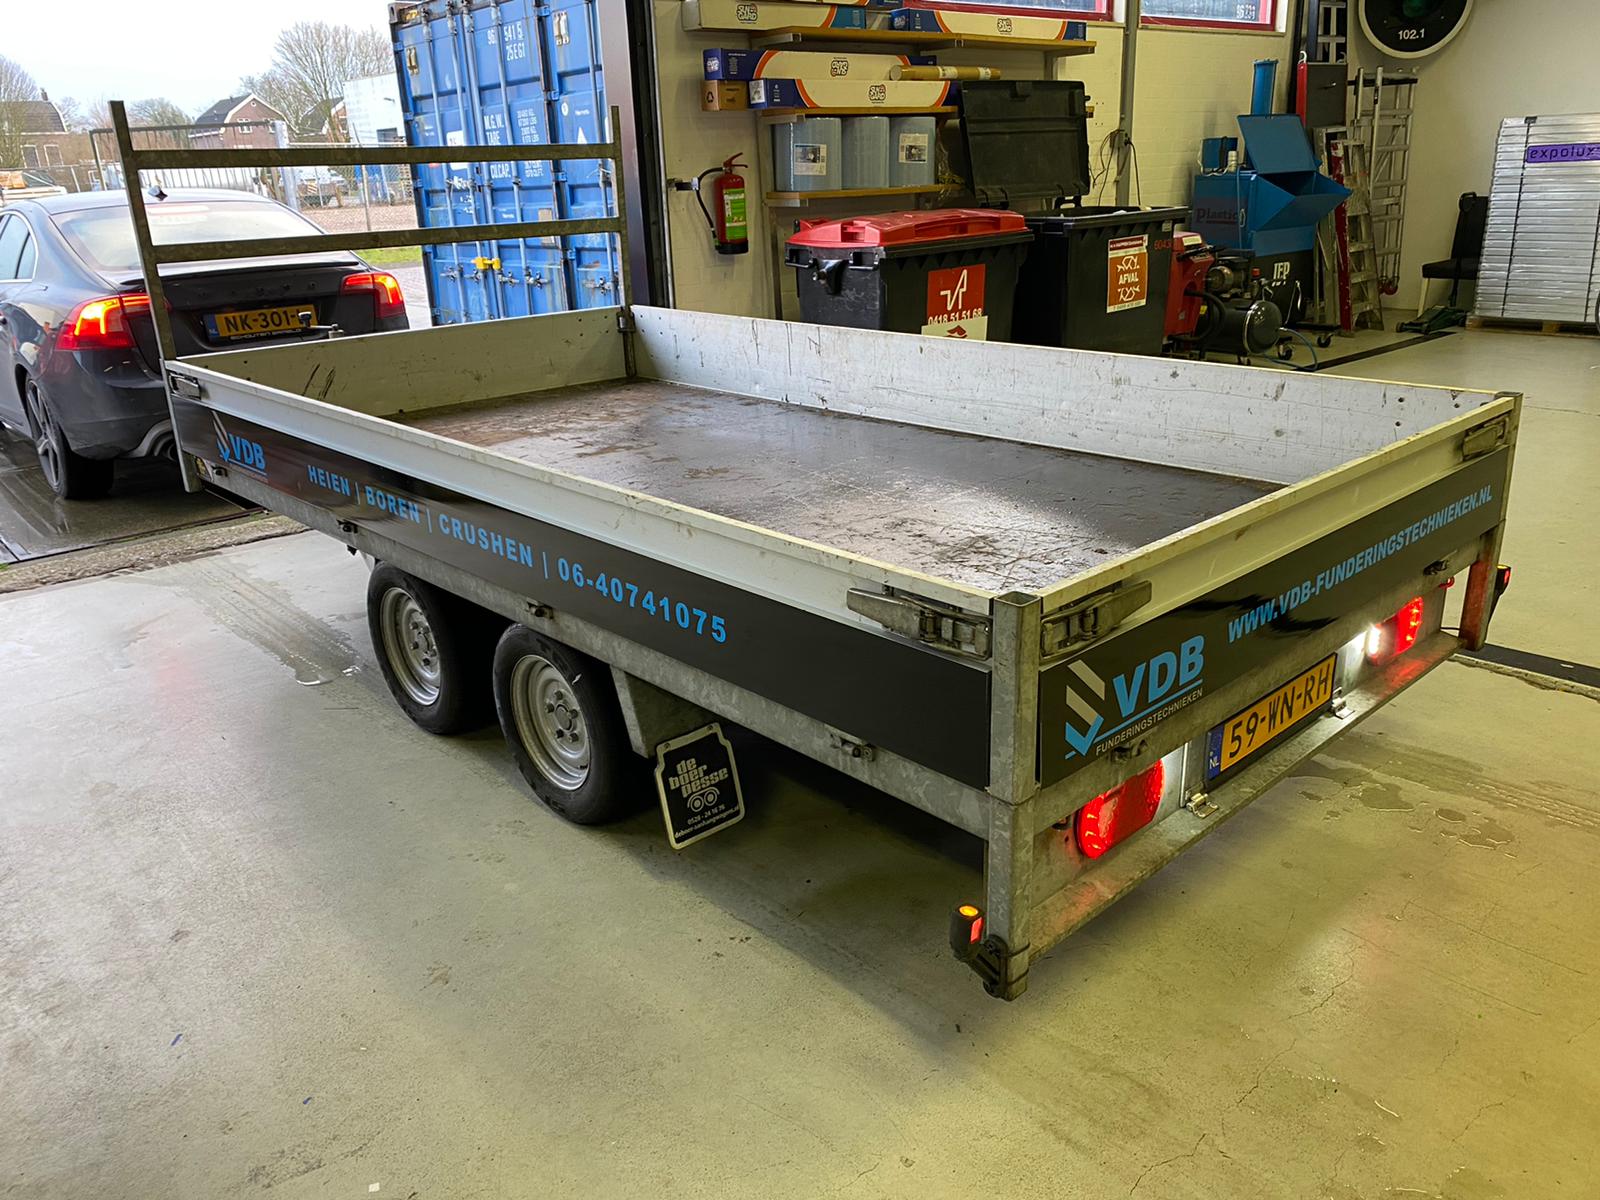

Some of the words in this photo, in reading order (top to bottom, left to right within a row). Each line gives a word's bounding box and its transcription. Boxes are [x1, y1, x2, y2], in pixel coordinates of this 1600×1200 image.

[1398, 28, 1425, 40] 102.1
[1530, 145, 1594, 160] expolux
[1119, 272, 1139, 285] AFVAL
[223, 305, 311, 334] NK-301-
[228, 432, 267, 471] VDB
[307, 464, 351, 497] HEIEN
[364, 485, 420, 525] BOREN
[438, 513, 534, 568] CRUSHEN
[557, 557, 727, 643] 06-40741075
[1227, 484, 1493, 645] WWW.VDB-FUNDERINGSTECHNIEKEN.NL
[1112, 634, 1206, 718] VDB
[1095, 687, 1204, 757] FUNDERINGSTECHNIEKEN
[1209, 756, 1220, 769] NL
[1229, 663, 1331, 759] 59-WN-RH
